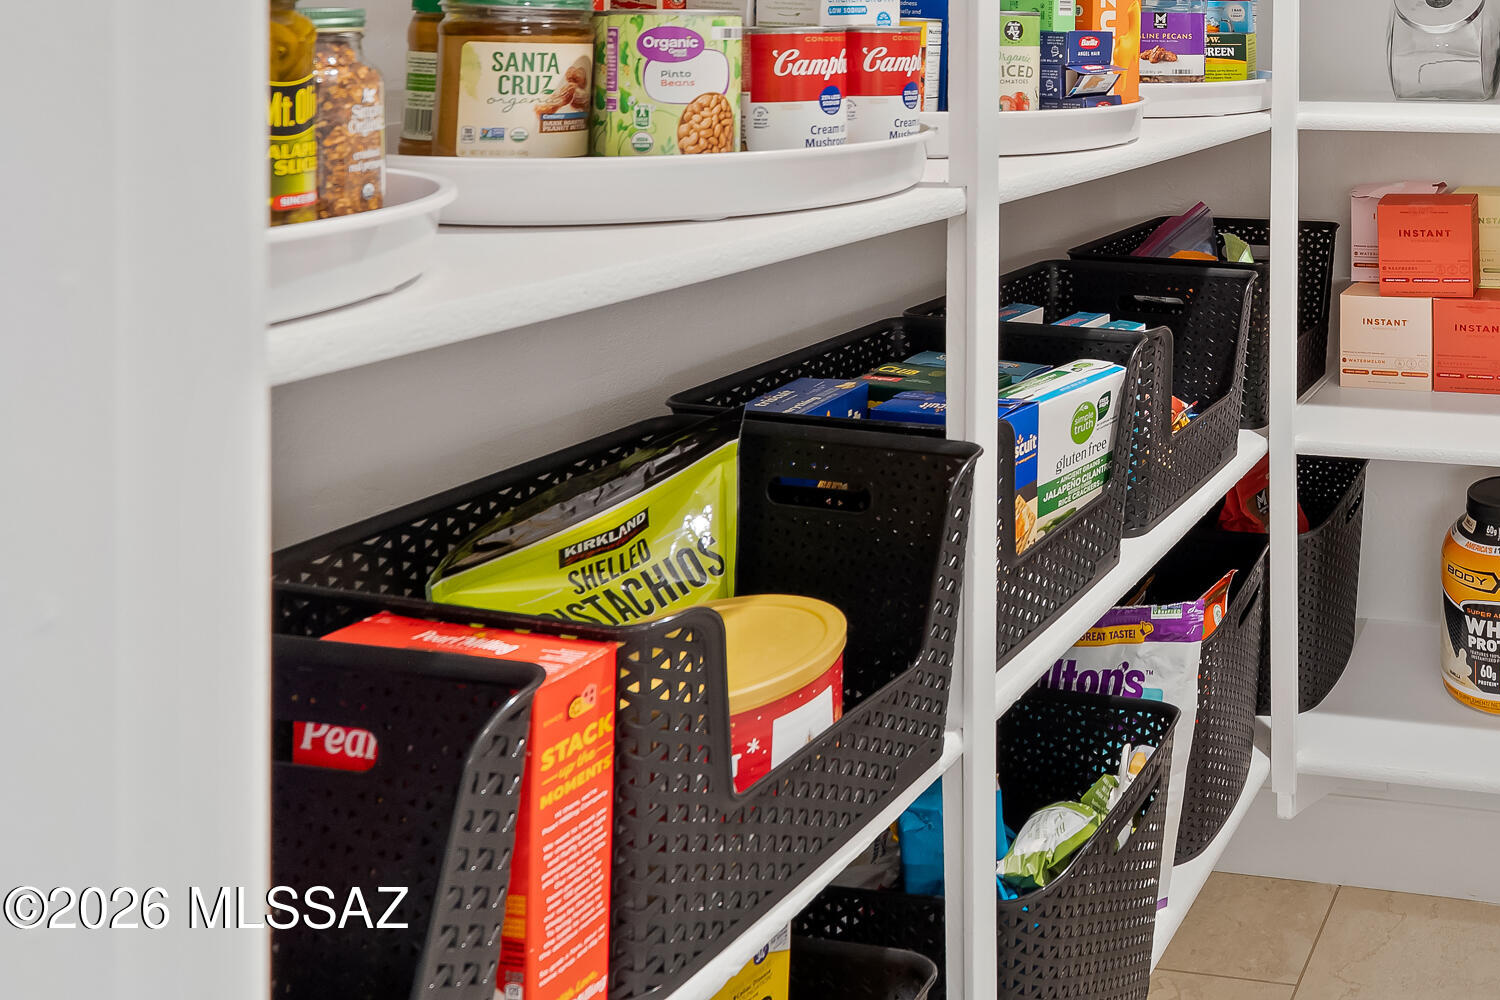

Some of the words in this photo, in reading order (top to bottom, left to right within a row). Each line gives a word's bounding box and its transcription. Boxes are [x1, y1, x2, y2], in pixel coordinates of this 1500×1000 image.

[828, 6, 842, 14] LOW
[642, 35, 700, 51] Organic
[1162, 33, 1193, 41] PECANS
[491, 51, 560, 74] SANTA
[660, 69, 692, 78] Pinto
[498, 74, 555, 96] CRUZ
[660, 79, 696, 87] Beans
[810, 125, 840, 135] Cream
[894, 117, 918, 128] Cream
[1398, 229, 1452, 238] INSTANT
[1362, 317, 1409, 327] INSTANT
[878, 365, 921, 376] CLUB
[1074, 412, 1095, 425] simple
[1074, 418, 1094, 435] truth
[1055, 448, 1087, 475] gluten
[1088, 439, 1107, 455] free
[1060, 466, 1082, 483] ANCIENT
[1057, 495, 1072, 508] RICE
[1072, 481, 1101, 501] CRACKERS
[564, 511, 647, 560] KIRKLAND
[1465, 541, 1493, 554] AMERICA'S
[567, 538, 651, 596] SHELLED
[1447, 563, 1488, 586] BODY
[1466, 607, 1491, 618] SUPER
[1109, 629, 1136, 639] TASTE!
[1480, 664, 1497, 681] 60g
[540, 711, 613, 772] STACK
[558, 762, 577, 779] up
[577, 748, 597, 766] the
[539, 752, 612, 810] MOMENTS
